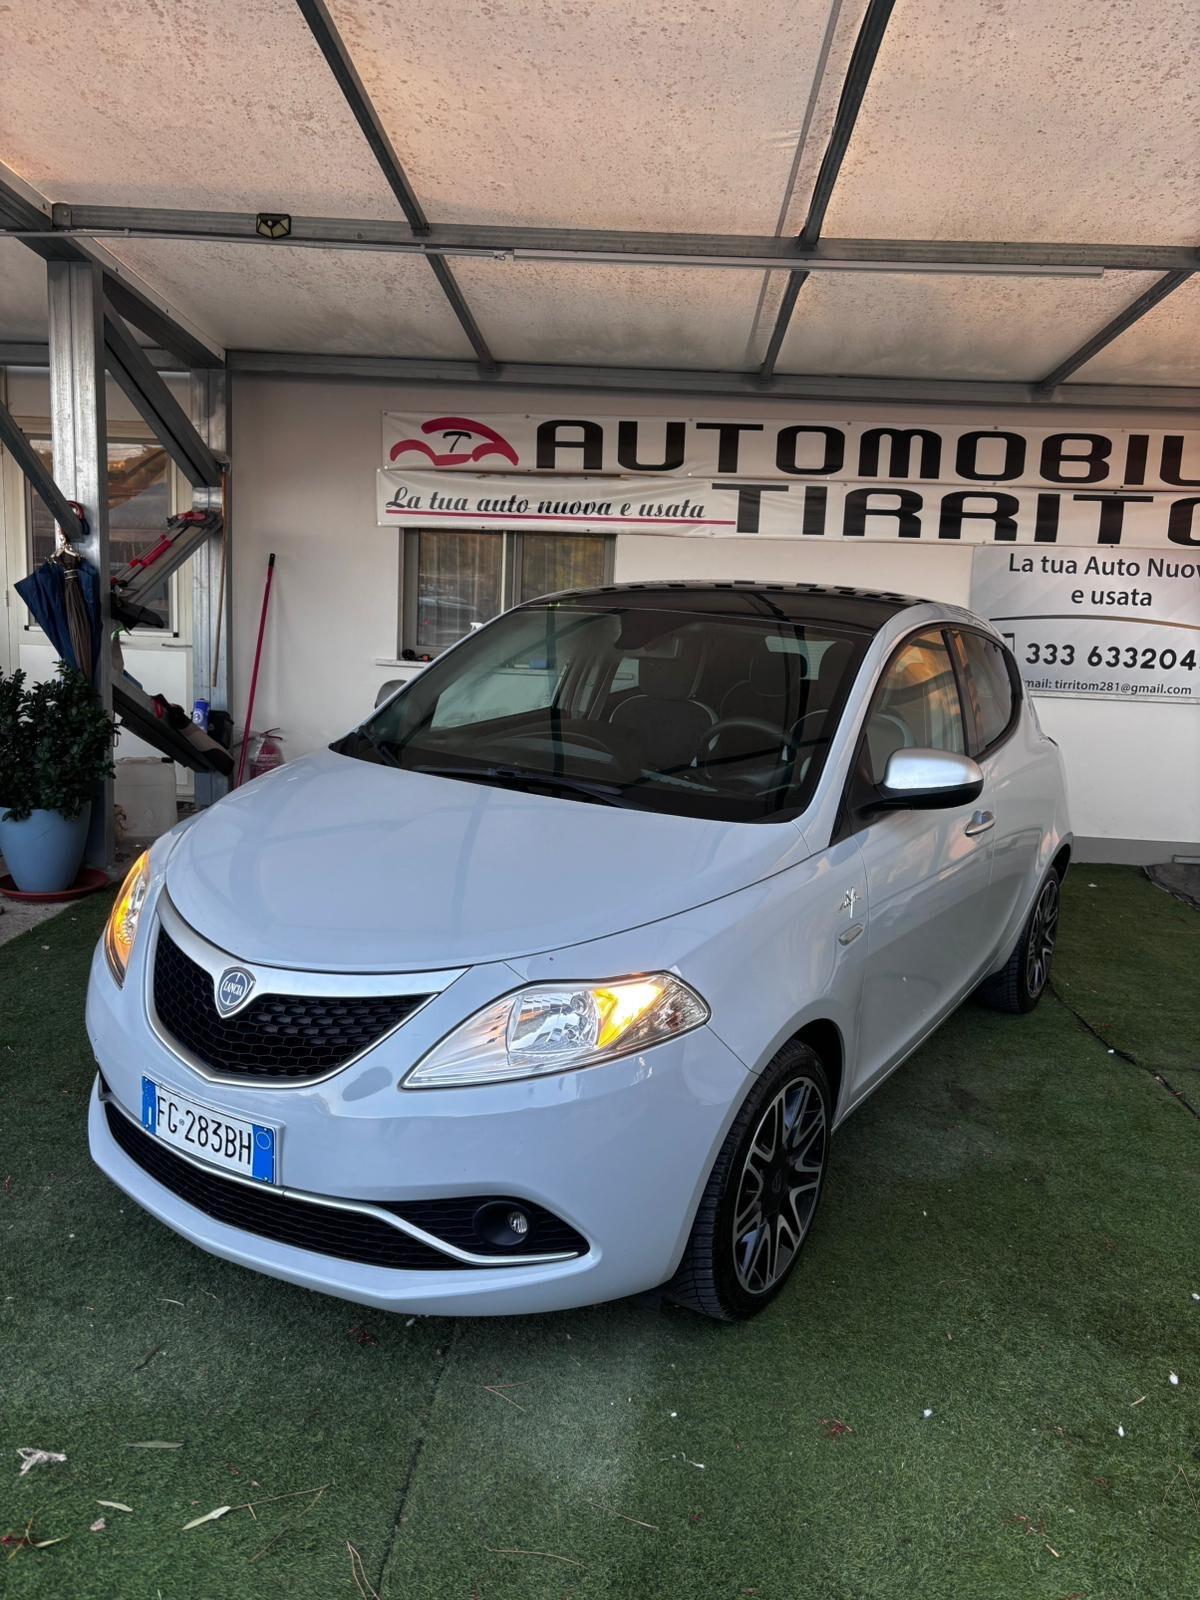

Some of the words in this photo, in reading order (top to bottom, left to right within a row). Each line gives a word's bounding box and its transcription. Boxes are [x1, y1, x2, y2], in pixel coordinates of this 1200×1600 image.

[385, 486, 422, 509] La
[429, 491, 468, 511] tua
[476, 494, 529, 513] auto
[537, 499, 613, 516] nuova
[620, 502, 632, 517] e
[638, 499, 705, 518] usata
[1009, 553, 1033, 573] La
[1041, 555, 1077, 575] tua
[1084, 556, 1140, 577] Auto
[1071, 588, 1084, 604] e
[1091, 587, 1152, 607] usata
[1025, 643, 1075, 666] 333
[1087, 646, 1197, 671] 633204
[1054, 679, 1192, 696] tirritom281@gmail.com
[223, 980, 244, 996] LANCIA
[156, 1095, 179, 1135] FG
[184, 1110, 252, 1165] 283BH
